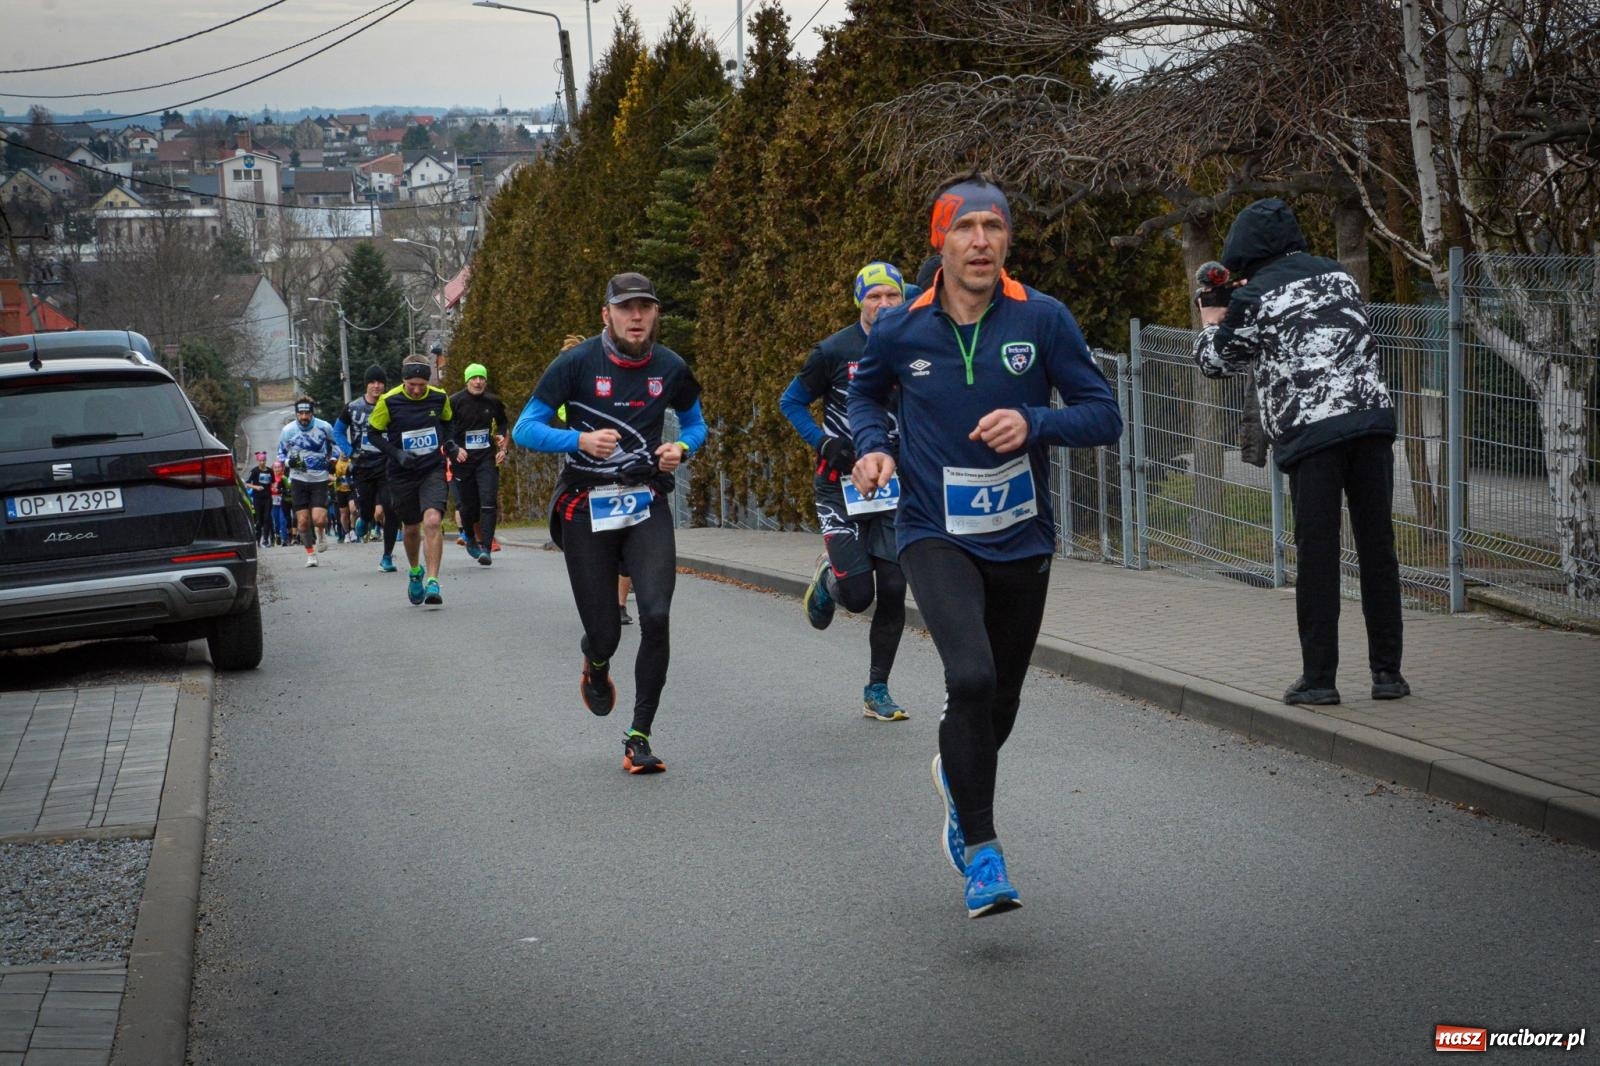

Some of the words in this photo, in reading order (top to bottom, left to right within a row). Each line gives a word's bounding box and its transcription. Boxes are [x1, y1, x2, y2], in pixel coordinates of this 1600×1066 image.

[409, 435, 432, 449] 200
[20, 497, 46, 515] OP
[56, 490, 116, 512] 1239P
[608, 494, 637, 516] 29
[970, 481, 1010, 514] 47
[43, 532, 99, 543] Ateca
